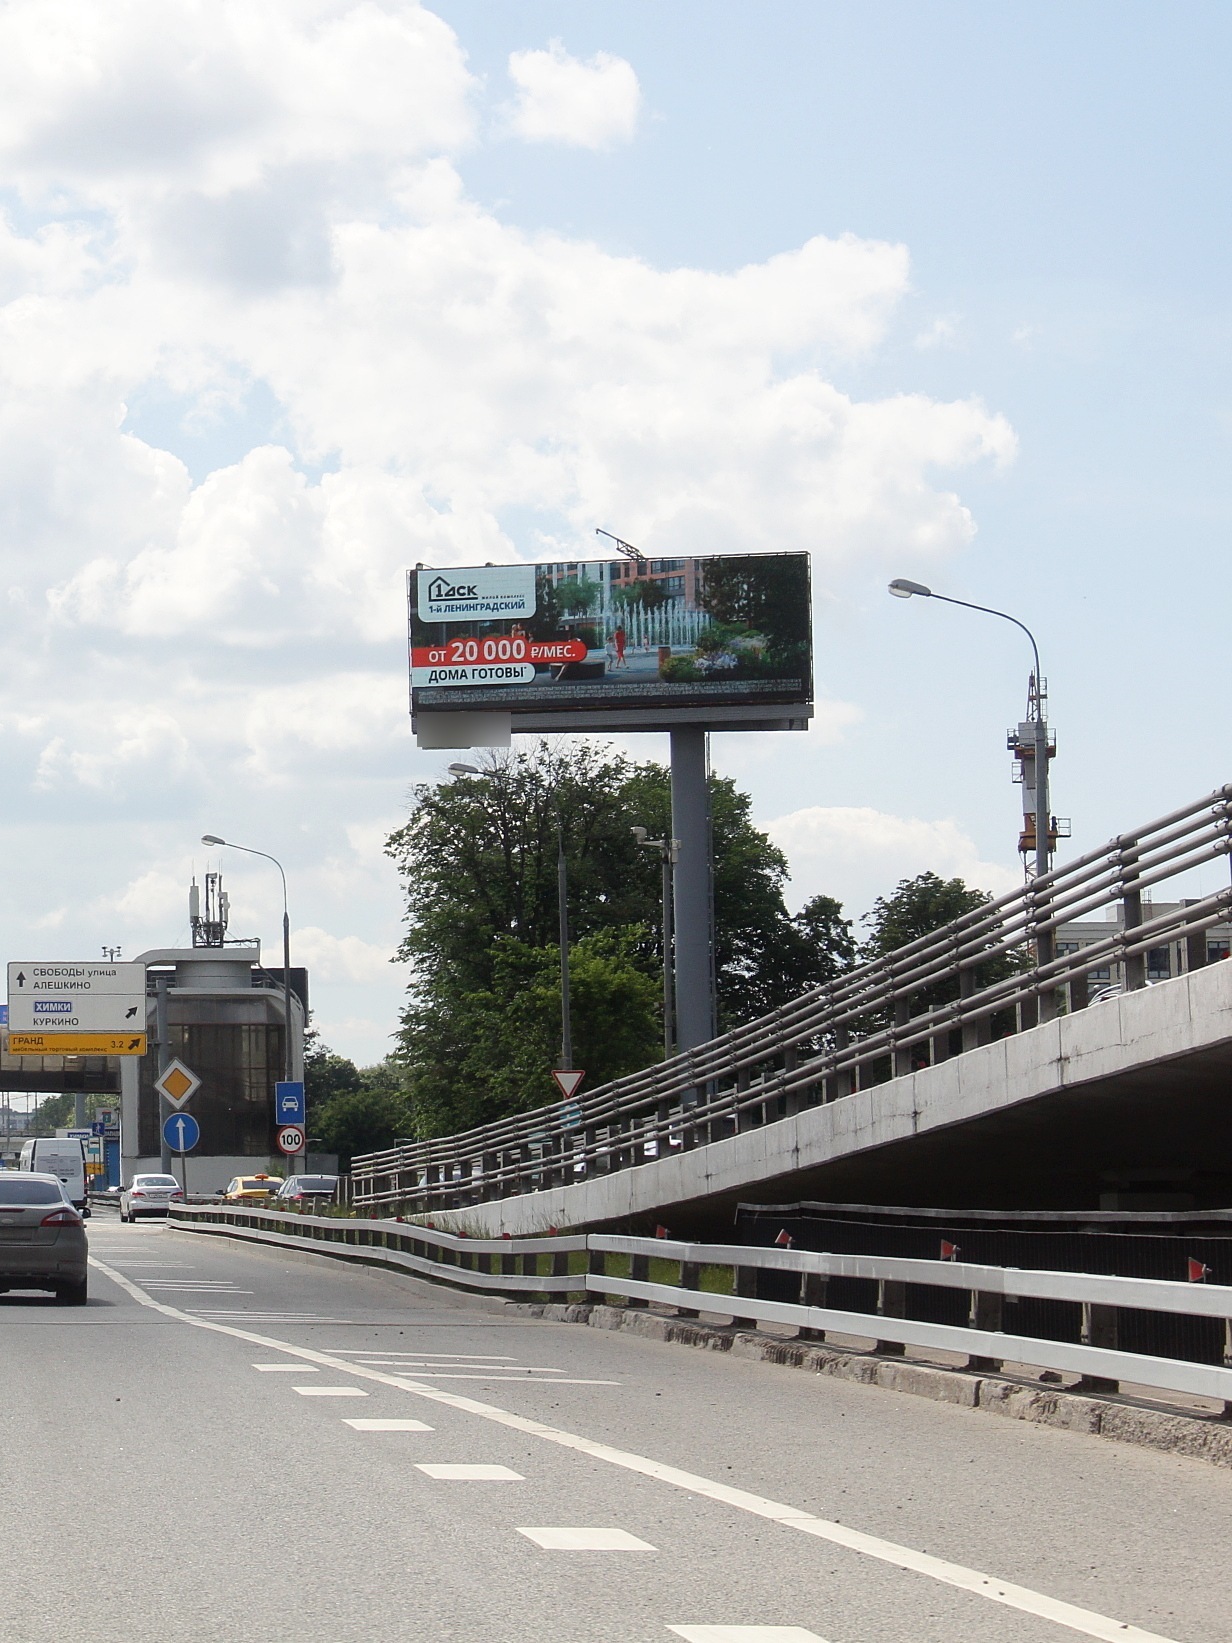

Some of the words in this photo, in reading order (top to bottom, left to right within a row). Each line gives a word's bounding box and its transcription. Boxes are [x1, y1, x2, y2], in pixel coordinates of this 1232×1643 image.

[443, 599, 526, 613] ЛЕНИНГРАДСКИЙ
[428, 651, 447, 663] ОТ
[451, 641, 478, 662] 20
[483, 639, 526, 660] 000
[429, 669, 469, 683] ДОМА
[33, 968, 85, 977] СВОБОДЫ
[88, 969, 117, 977] улица
[33, 981, 91, 989] АЛЕШКИНО
[36, 1003, 71, 1011] ХИМКИ
[33, 1018, 79, 1026] КУРКИНО
[13, 1037, 44, 1045] ГРАНД
[110, 1041, 124, 1049] 3.2
[281, 1134, 301, 1146] 100
